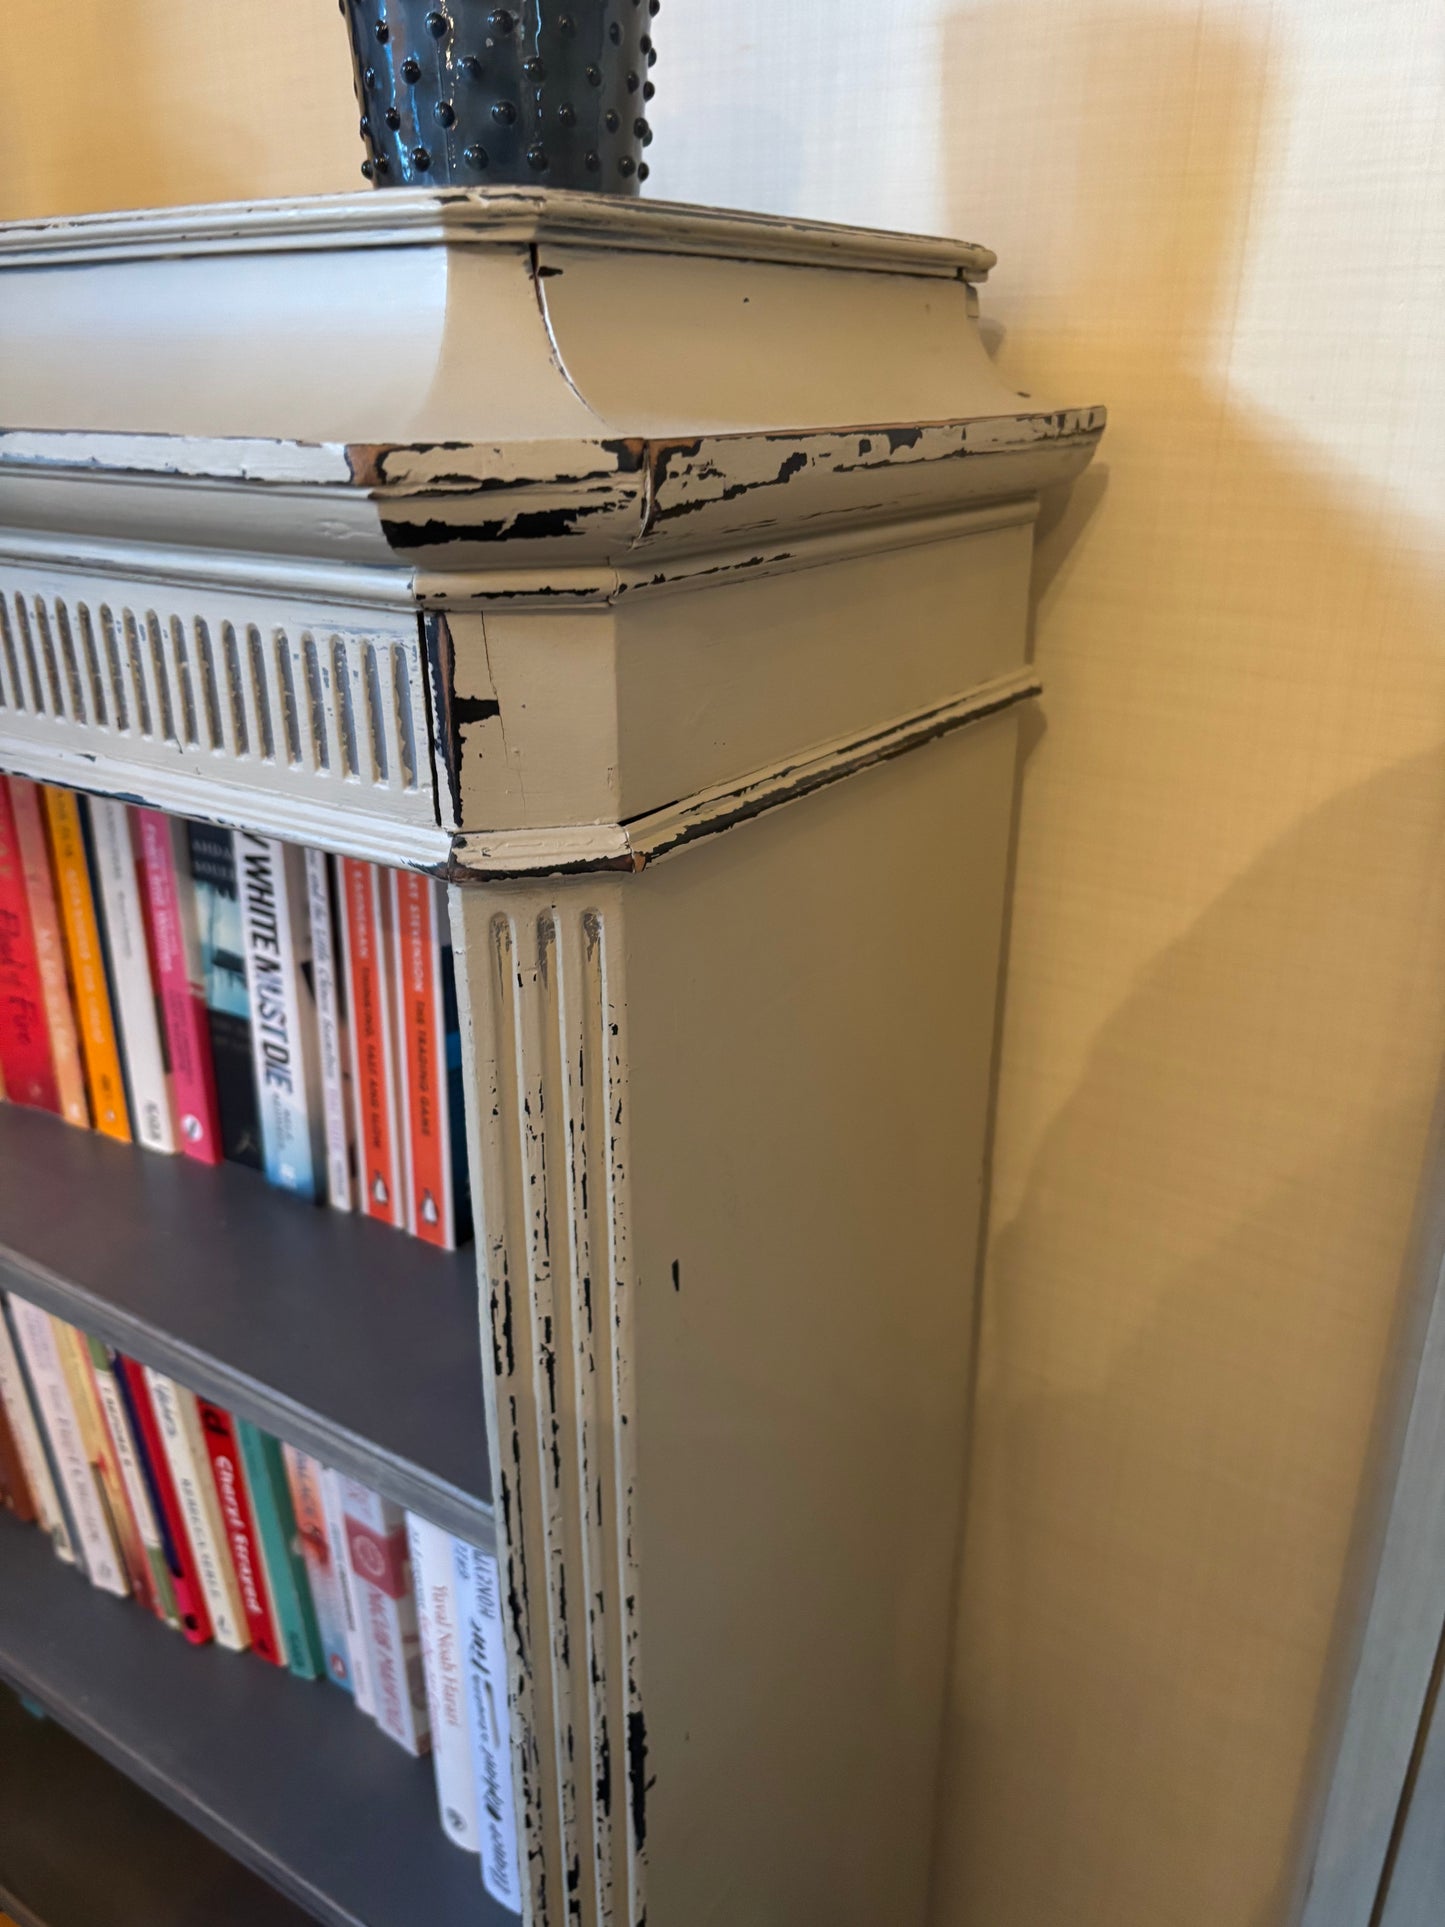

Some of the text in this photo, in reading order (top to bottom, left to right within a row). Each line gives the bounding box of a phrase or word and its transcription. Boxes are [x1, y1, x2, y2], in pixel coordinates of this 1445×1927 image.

[244, 852, 281, 956] WHITE
[255, 955, 289, 1040] MUST
[263, 1039, 294, 1095] DIE
[217, 1454, 244, 1530] Cheryl
[431, 1583, 462, 1728] Yuval Noah Harari
